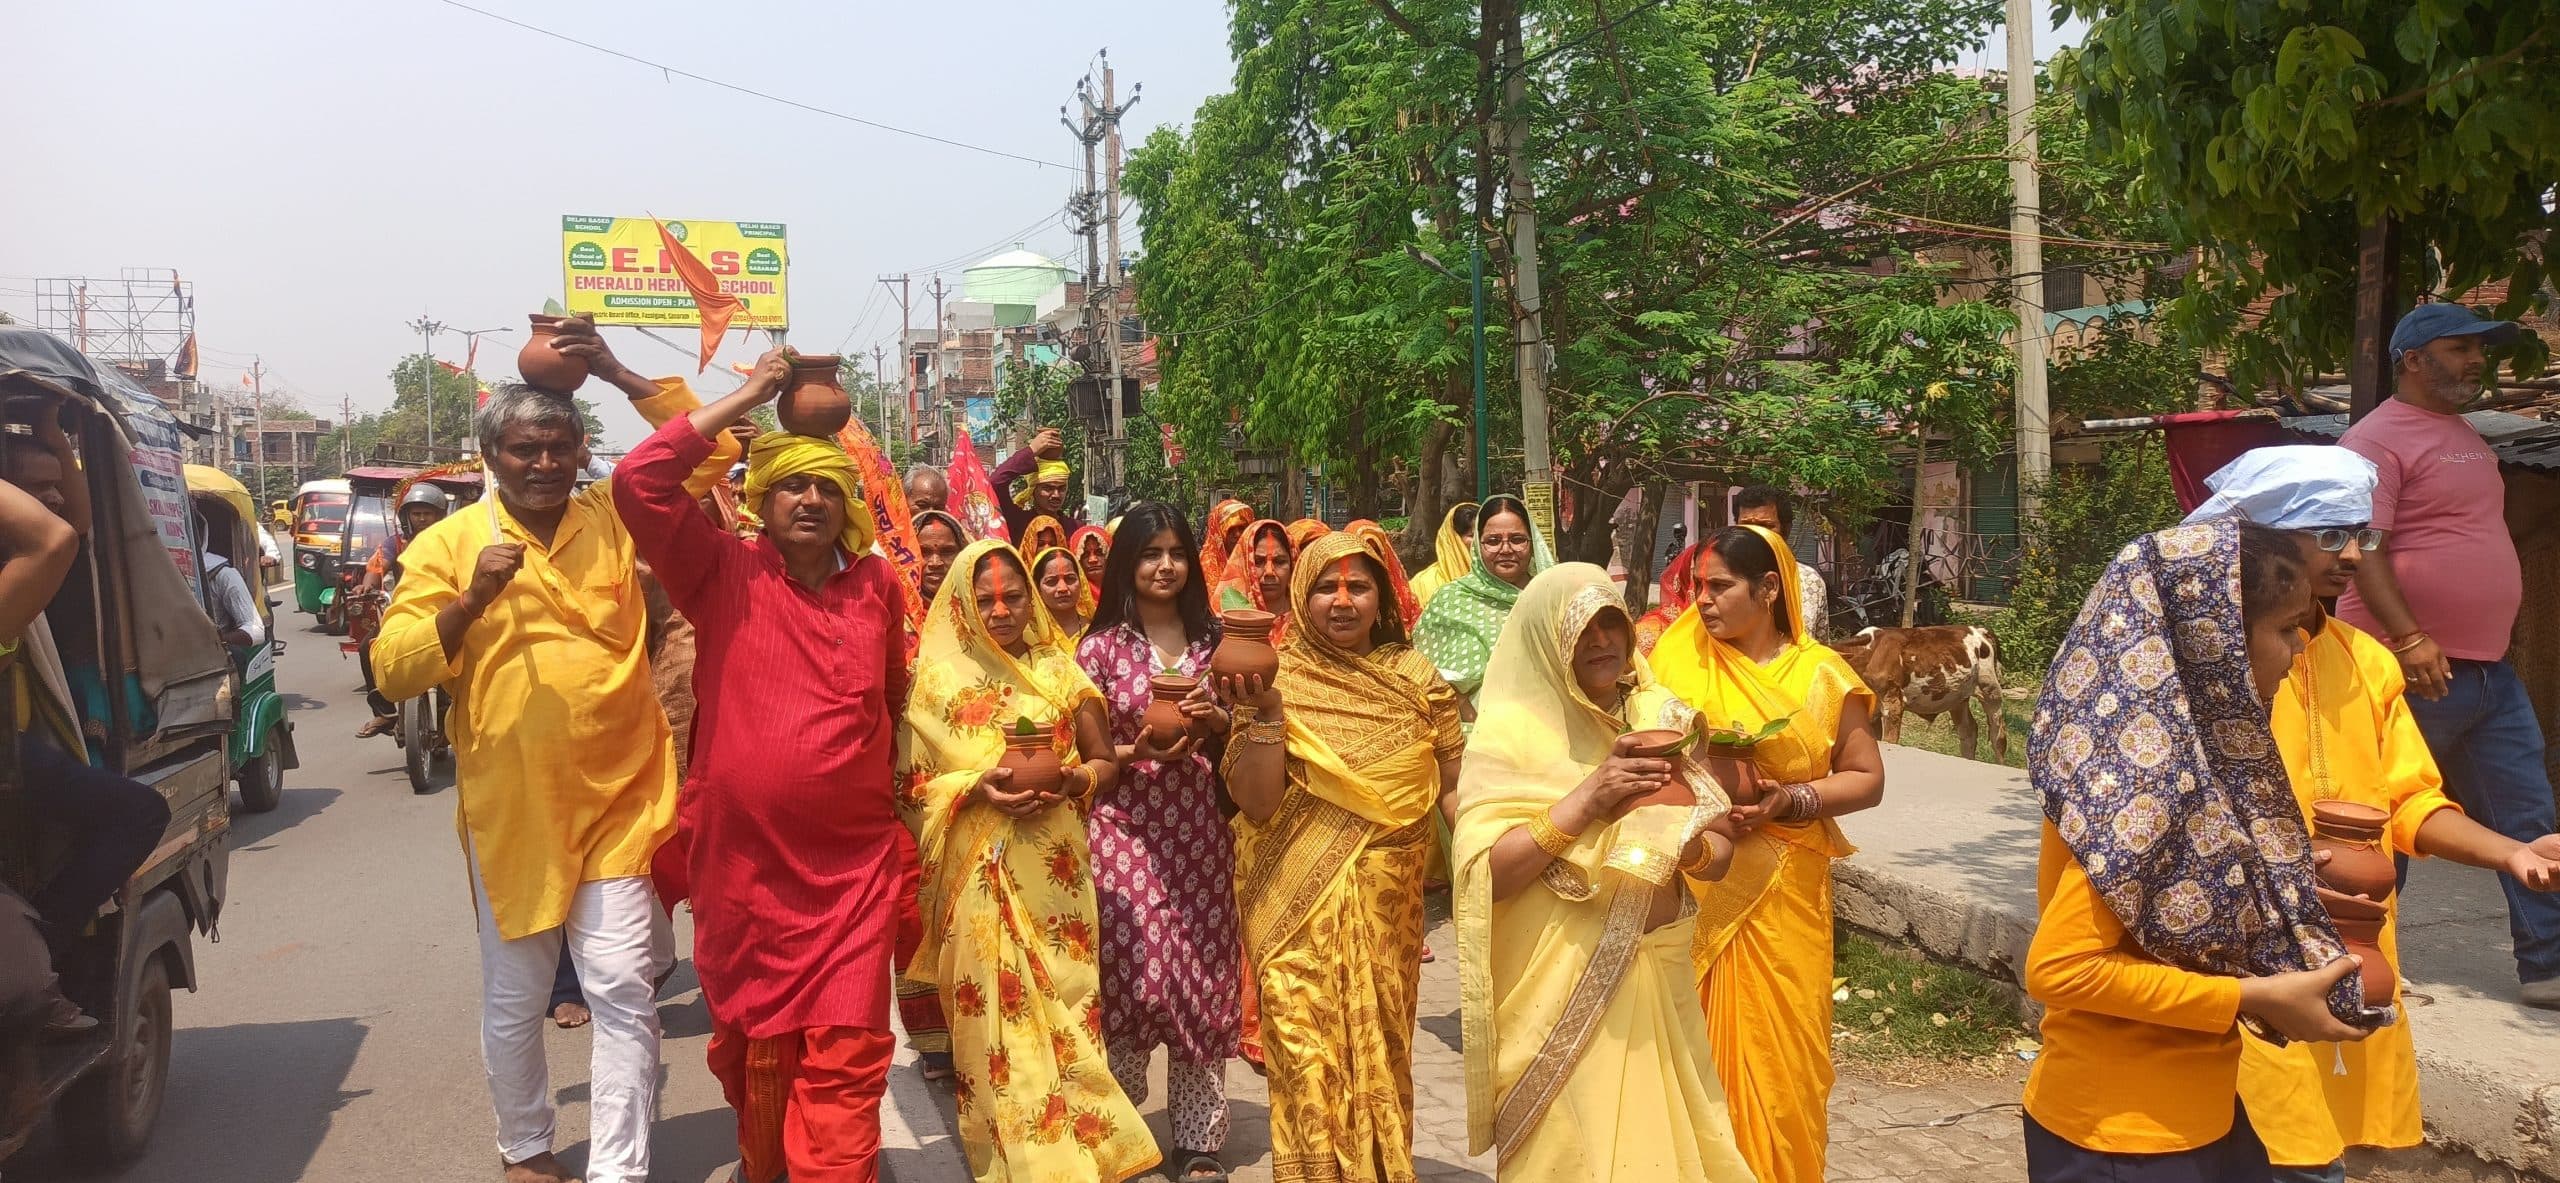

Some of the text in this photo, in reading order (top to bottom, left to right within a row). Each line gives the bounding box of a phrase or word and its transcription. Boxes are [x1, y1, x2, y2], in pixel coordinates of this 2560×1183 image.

[575, 276, 777, 295] EMERALD HERIT SCHOOL
[610, 297, 652, 306] ADMISSION
[653, 298, 672, 306] OPEN
[874, 490, 894, 533] जय
